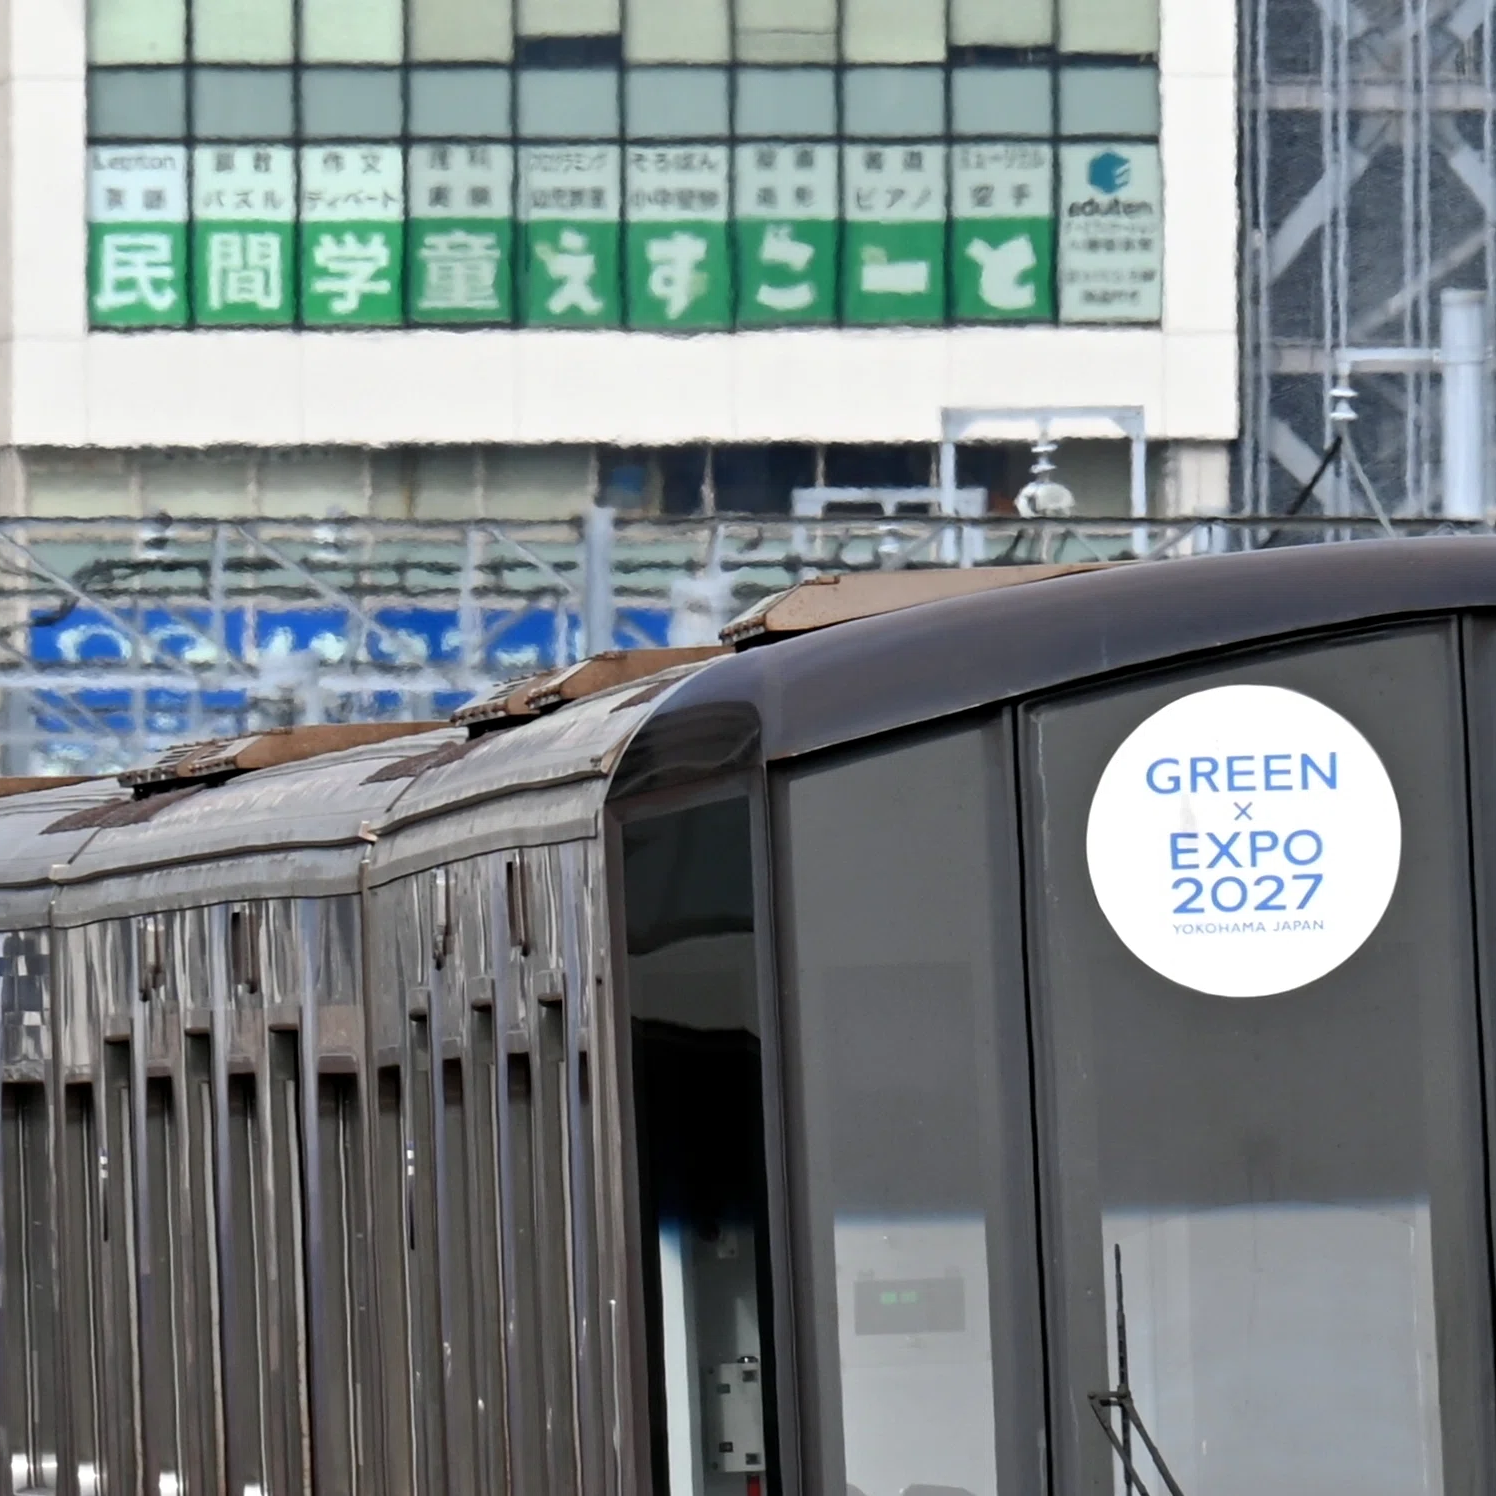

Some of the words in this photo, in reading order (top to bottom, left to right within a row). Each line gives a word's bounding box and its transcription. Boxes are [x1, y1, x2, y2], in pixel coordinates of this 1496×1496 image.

[202, 189, 284, 209] パズル
[306, 188, 402, 210] ディベート
[856, 187, 932, 211] ピアノ
[1145, 751, 1338, 795] GREEN
[1168, 828, 1324, 870] EXPO
[1170, 872, 1324, 915] 2027
[1172, 920, 1267, 936] YOKOHAMA
[1272, 919, 1325, 933] JAPAN
